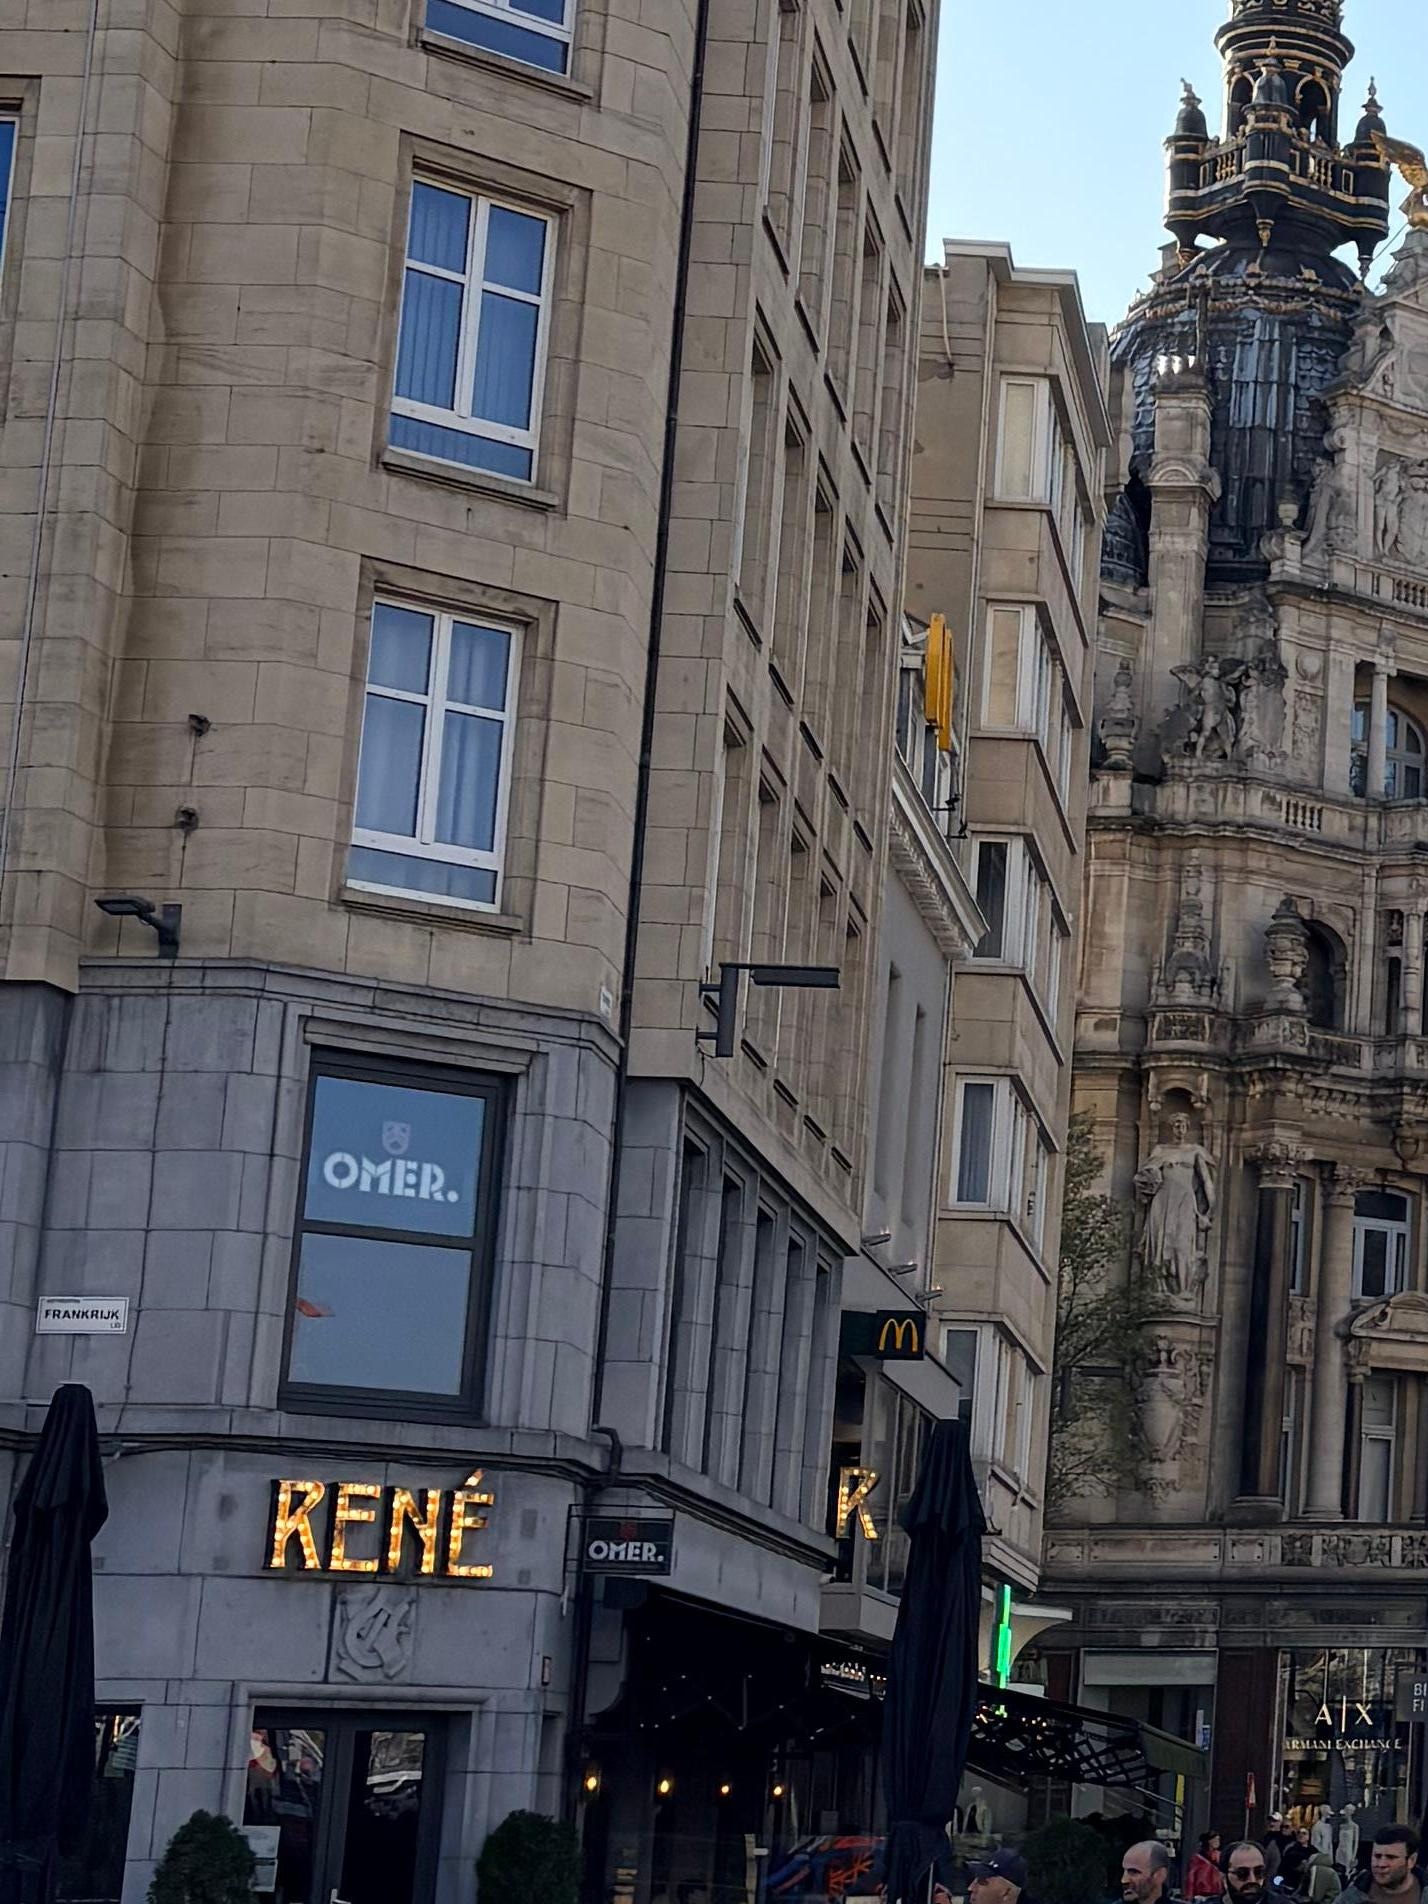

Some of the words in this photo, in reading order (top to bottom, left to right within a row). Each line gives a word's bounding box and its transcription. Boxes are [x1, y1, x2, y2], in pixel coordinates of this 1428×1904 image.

[323, 1150, 460, 1203] OMER.
[45, 1308, 120, 1320] FRANKRIJK
[265, 1468, 495, 1578] RENÉ
[588, 1540, 665, 1562] OMER.
[1335, 1738, 1403, 1752] EXCHANGE
